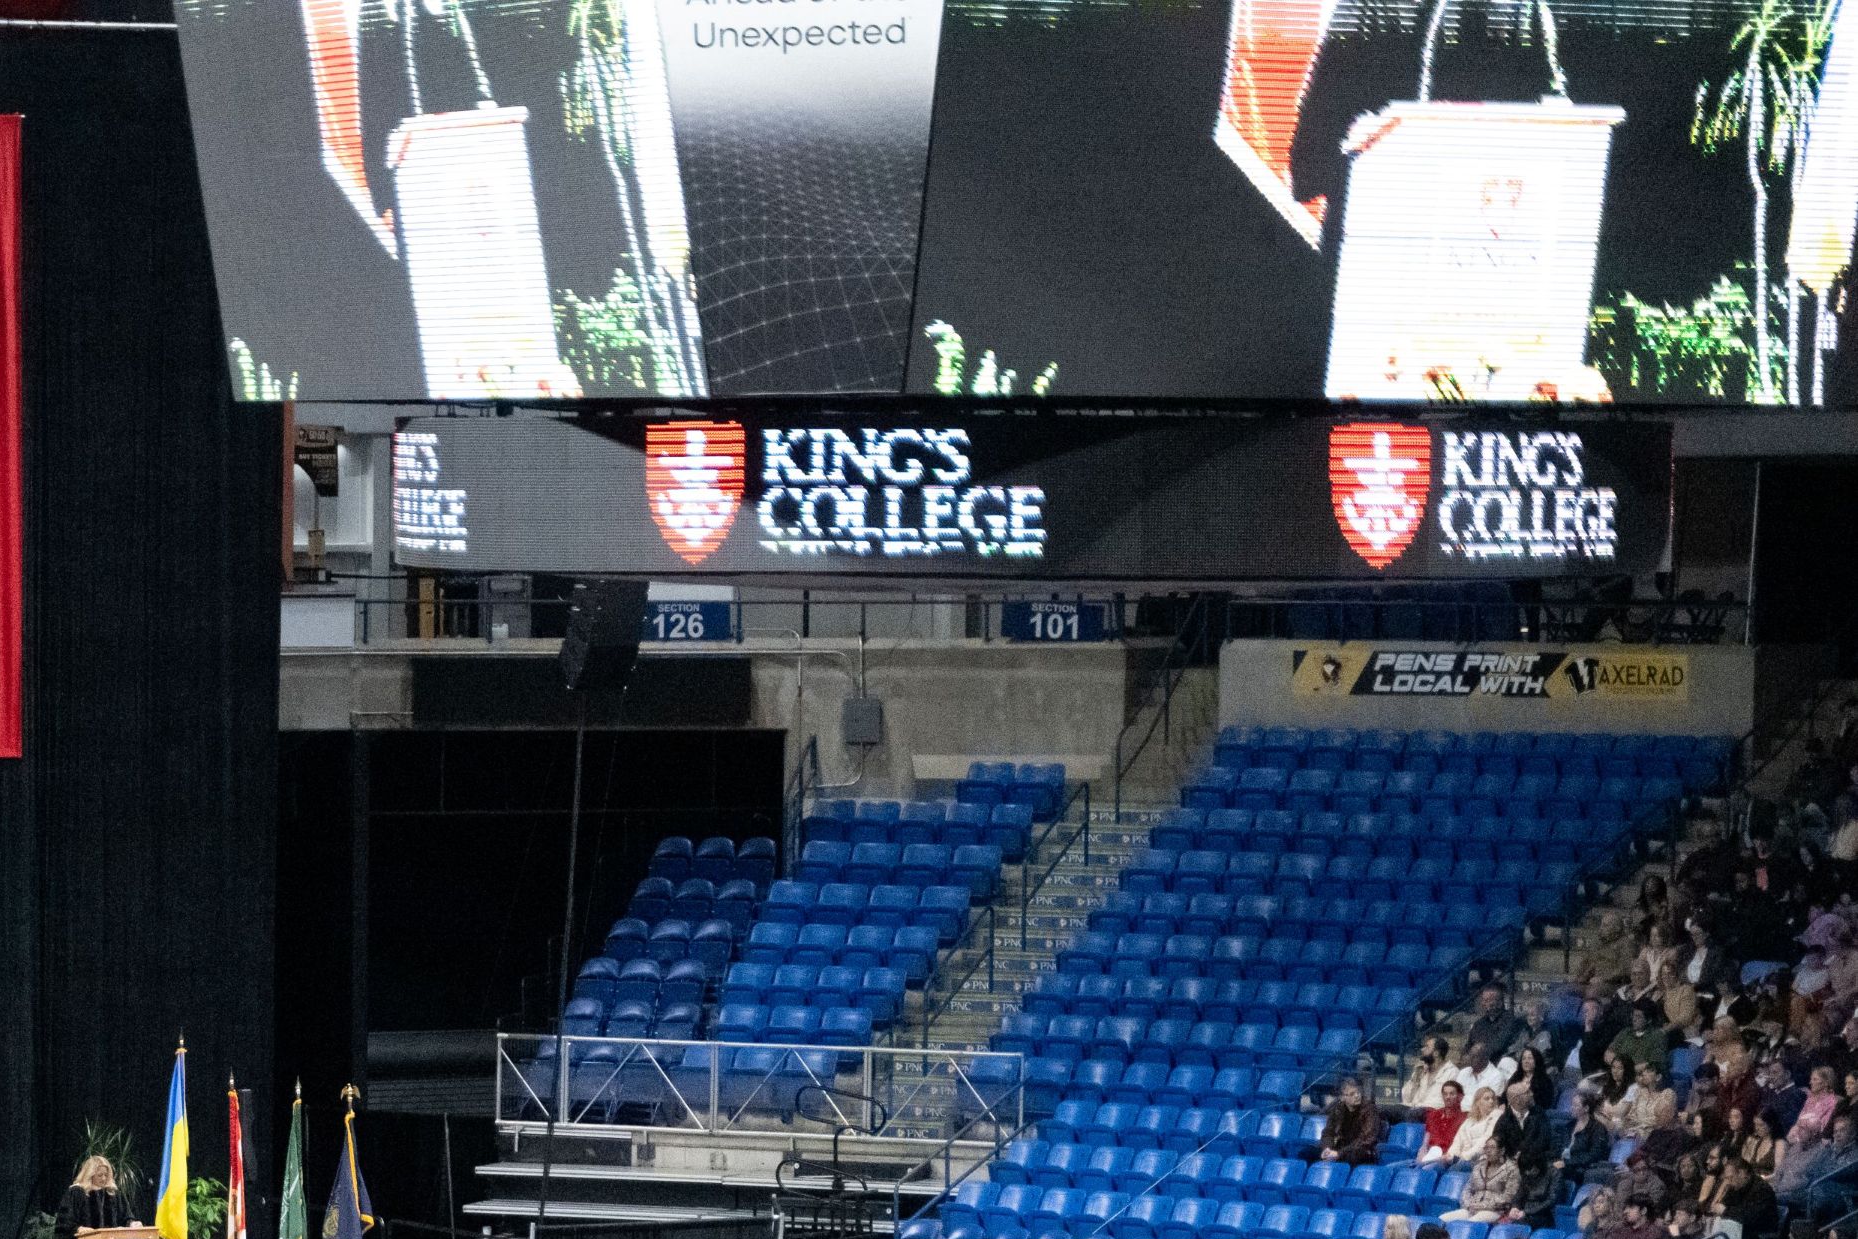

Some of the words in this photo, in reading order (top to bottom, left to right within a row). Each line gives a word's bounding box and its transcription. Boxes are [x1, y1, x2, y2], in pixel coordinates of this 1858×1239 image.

[693, 16, 906, 54] Unexpected
[758, 486, 1047, 540] COLLEGE
[1438, 487, 1619, 541] COLLEGE
[658, 603, 700, 613] SECTION
[1031, 602, 1077, 613] SECTION
[652, 612, 704, 639] 126
[1029, 612, 1079, 640] 101
[1374, 652, 1456, 673] PENS
[1463, 654, 1540, 674] PRINT
[1372, 673, 1471, 693] LOCAL
[1480, 675, 1545, 695] WITH
[1598, 665, 1684, 686] AXELRAD
[1036, 897, 1056, 906] PNC
[951, 1001, 971, 1011] PNC
[907, 1129, 929, 1139] PNC
